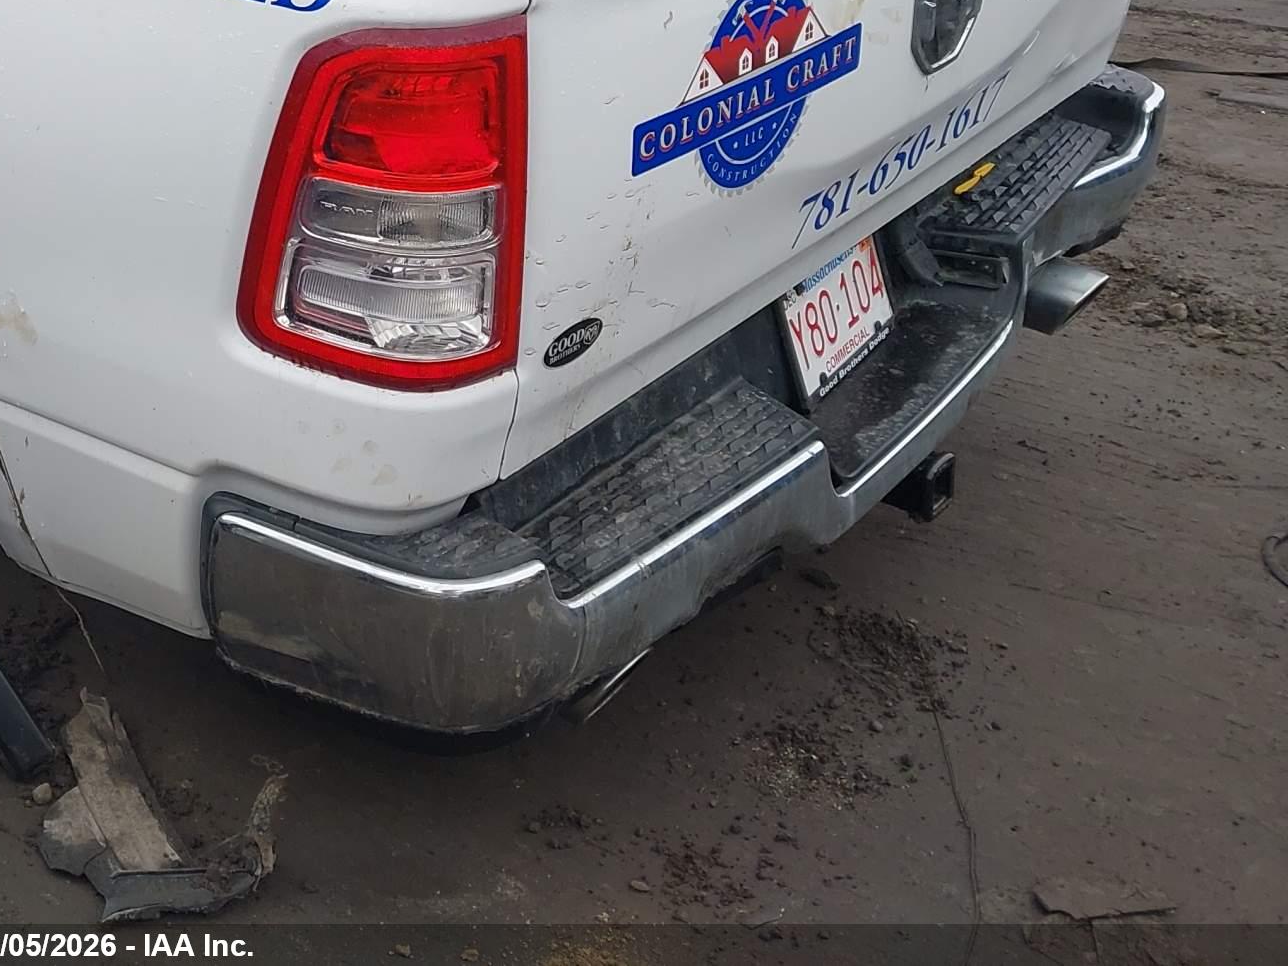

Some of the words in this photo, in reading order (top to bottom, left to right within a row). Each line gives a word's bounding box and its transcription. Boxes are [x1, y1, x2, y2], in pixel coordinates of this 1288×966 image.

[639, 78, 776, 161] COLONIAL
[787, 36, 857, 92] CRAFT
[706, 112, 799, 181] CONSTRUCTION
[744, 127, 765, 146] LLC
[791, 68, 1012, 250] 781-650-1617
[548, 328, 586, 357] GOOD
[819, 376, 839, 398] Good
[839, 349, 869, 378] Brothers
[869, 327, 890, 352] Dodge
[825, 327, 871, 373] COMMERCIAL
